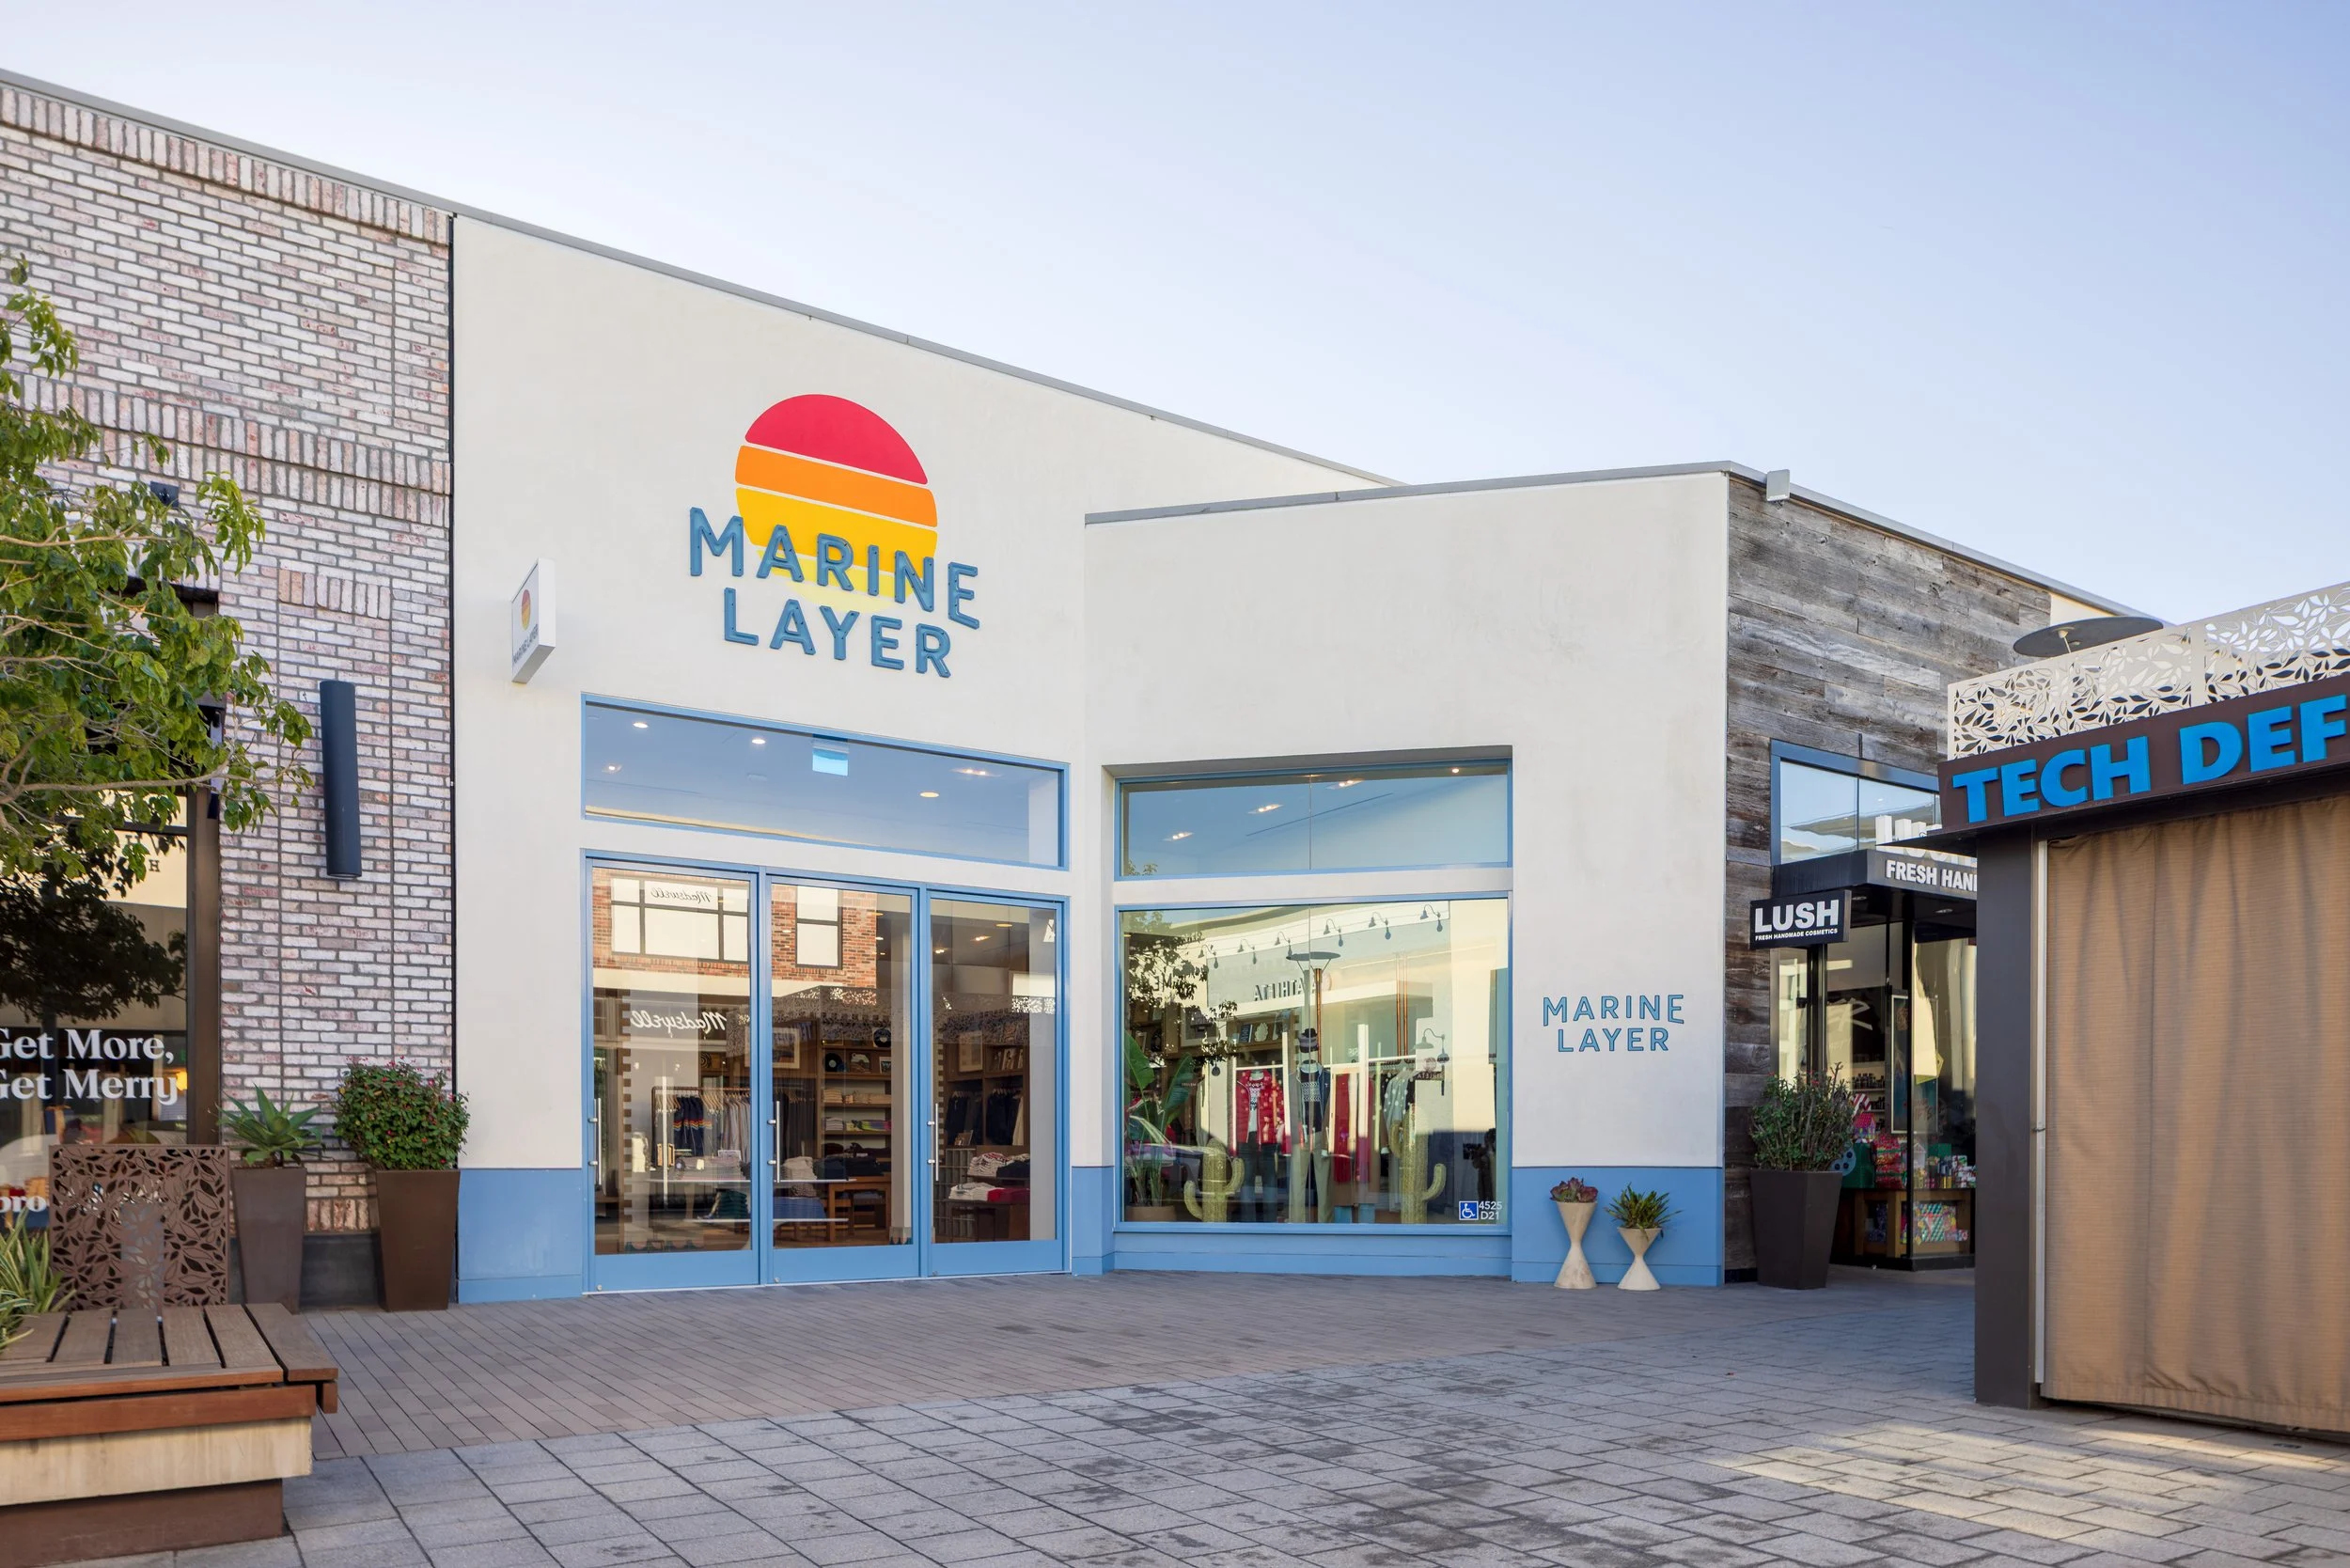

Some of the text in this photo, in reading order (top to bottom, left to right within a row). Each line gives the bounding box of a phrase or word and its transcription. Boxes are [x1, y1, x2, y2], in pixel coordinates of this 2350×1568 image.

[690, 507, 979, 629] MARINE
[723, 587, 951, 678] LAYER
[1952, 736, 2152, 823] TECH
[1886, 859, 1937, 886] FRESH
[1754, 900, 1839, 933] LUSH
[1773, 931, 1804, 940] HANDMADE
[1805, 928, 1838, 936] COSMETICS
[1543, 994, 1684, 1027] MARINE
[65, 1029, 174, 1064] More,
[1558, 1027, 1669, 1052] LAYER
[62, 1068, 178, 1105] Merry
[1479, 1200, 1502, 1210] 4525
[1480, 1211, 1499, 1220] D21
